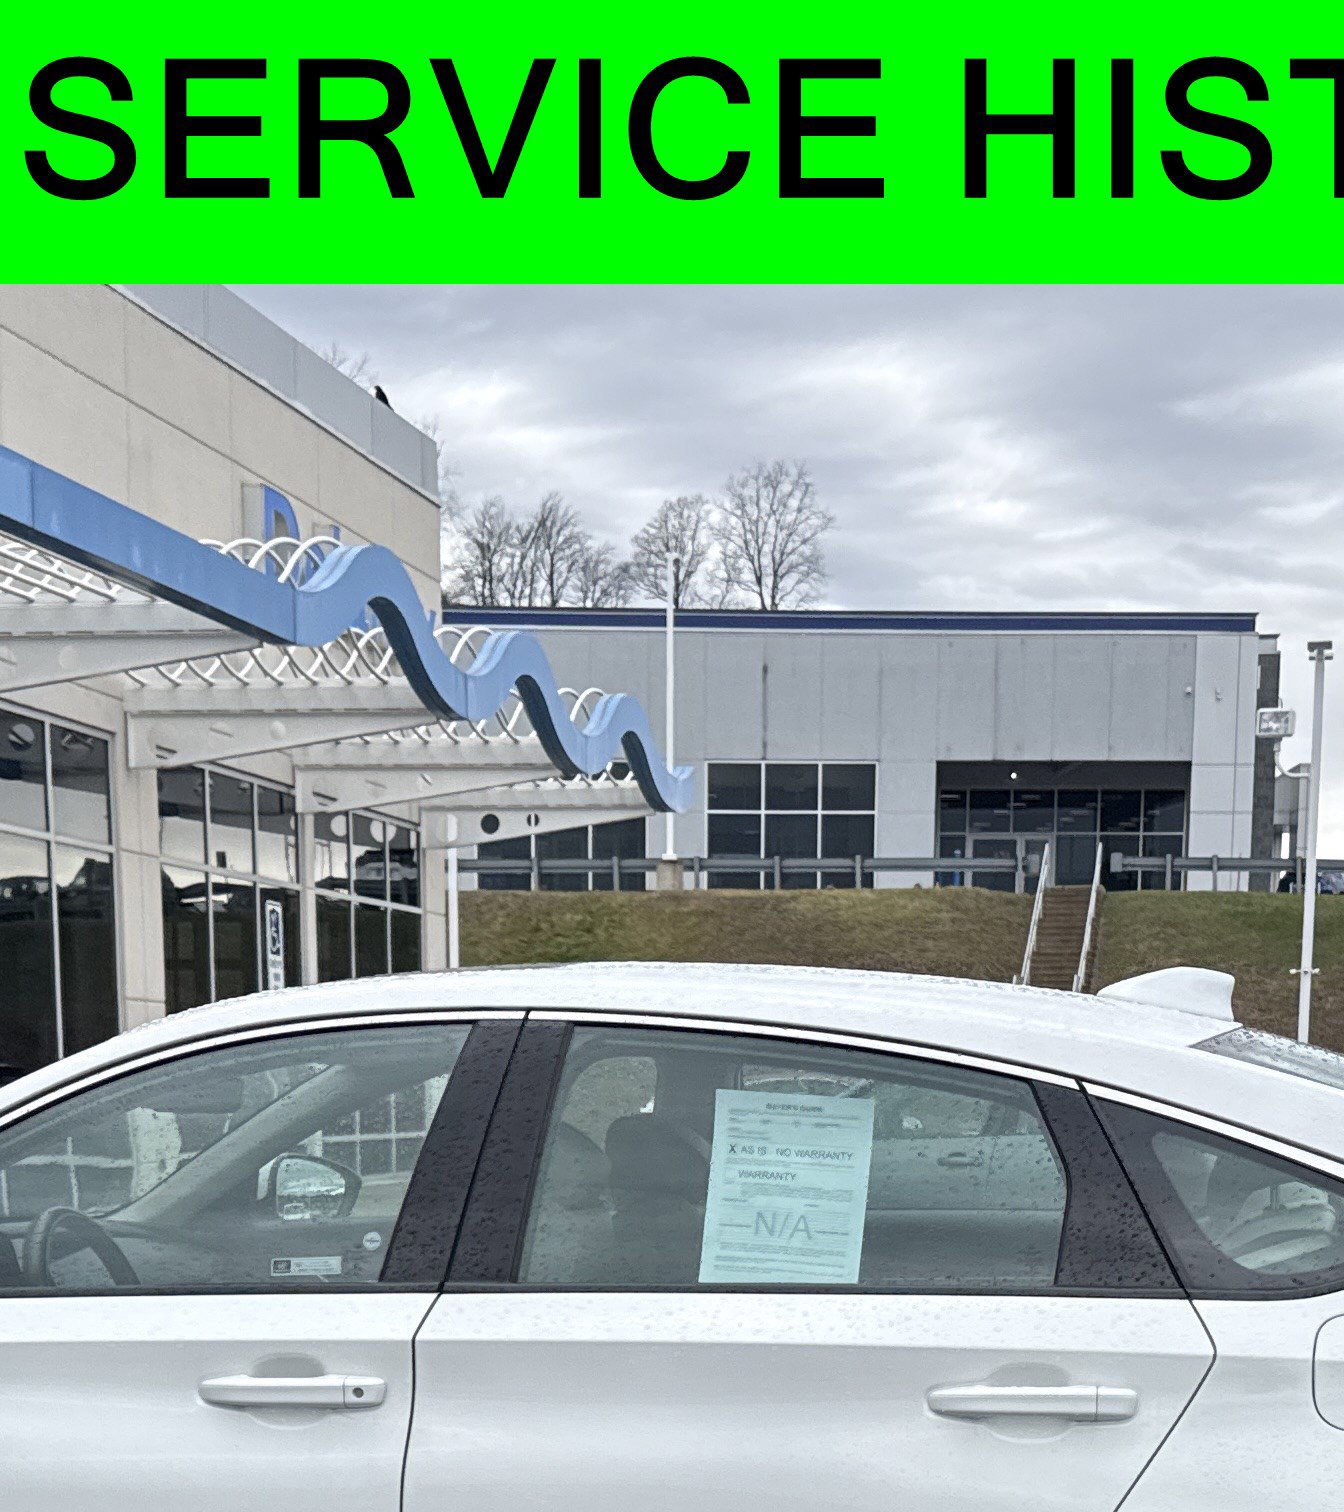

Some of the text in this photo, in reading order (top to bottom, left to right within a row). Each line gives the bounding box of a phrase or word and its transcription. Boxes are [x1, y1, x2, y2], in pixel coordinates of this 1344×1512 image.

[741, 1145, 755, 1155] AS
[775, 1148, 792, 1157] NO
[794, 1149, 855, 1161] WARRANTY
[738, 1169, 797, 1181] WARRANTY
[754, 1211, 814, 1241] N/A
